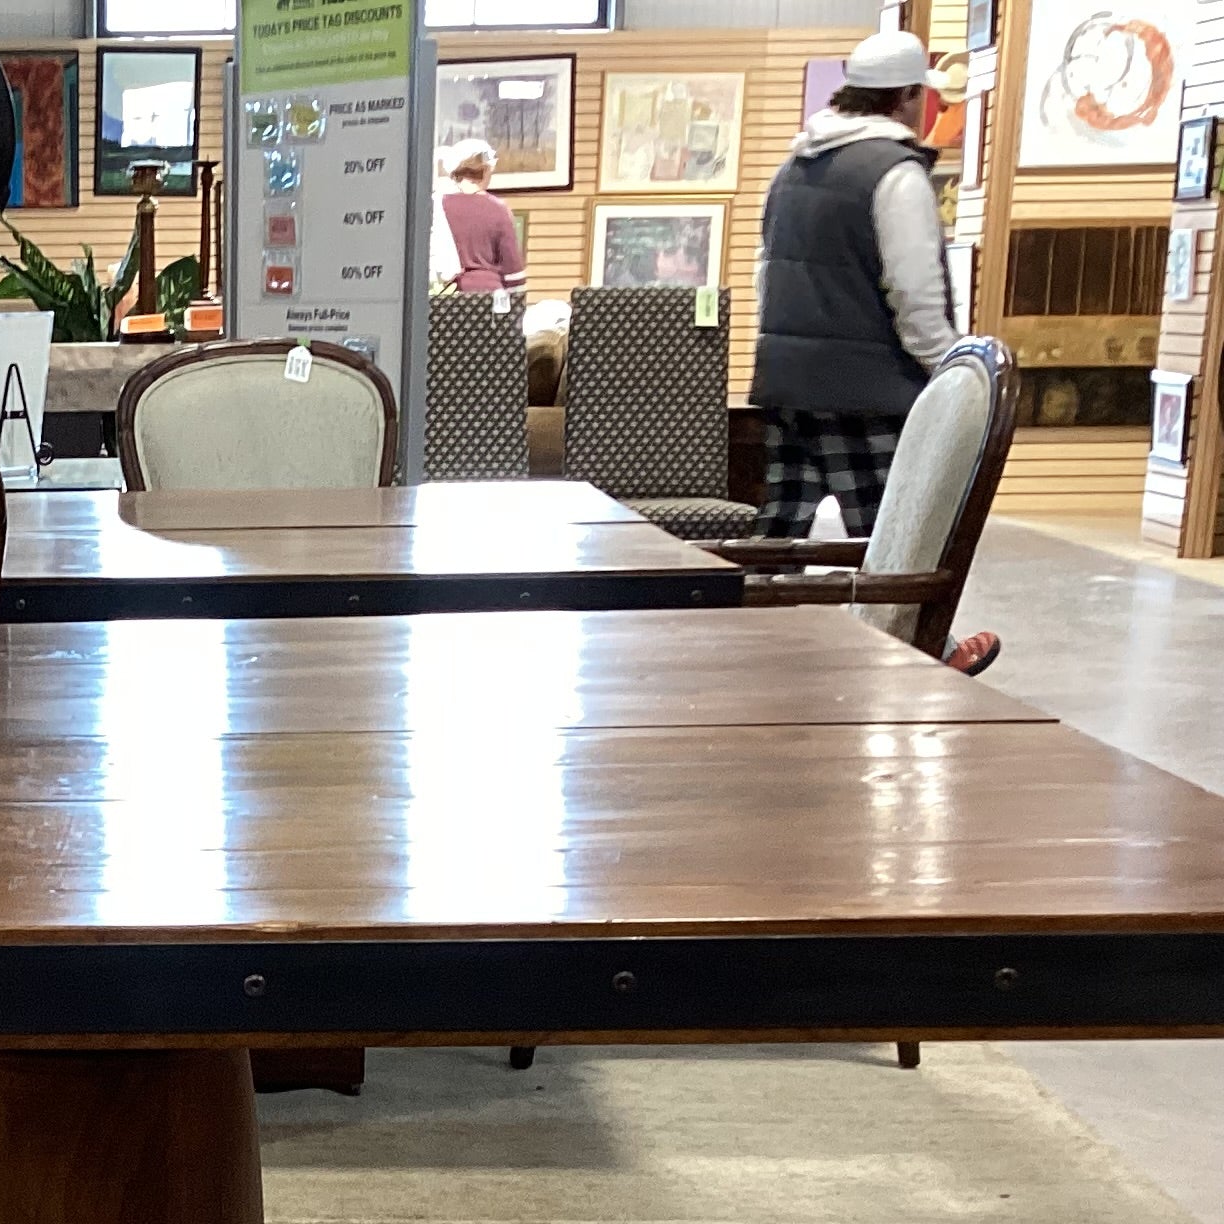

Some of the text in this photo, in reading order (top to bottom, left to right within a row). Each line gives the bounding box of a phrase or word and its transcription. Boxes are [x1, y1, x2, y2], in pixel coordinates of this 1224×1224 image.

[292, 16, 319, 32] PRICE
[322, 13, 342, 28] TAG
[344, 4, 403, 26] DISCOUNTS
[329, 97, 405, 115] PRICE AS MARKED
[344, 157, 386, 174] 20% OFF
[343, 210, 385, 225] 40% OFF
[364, 265, 383, 279] OFF
